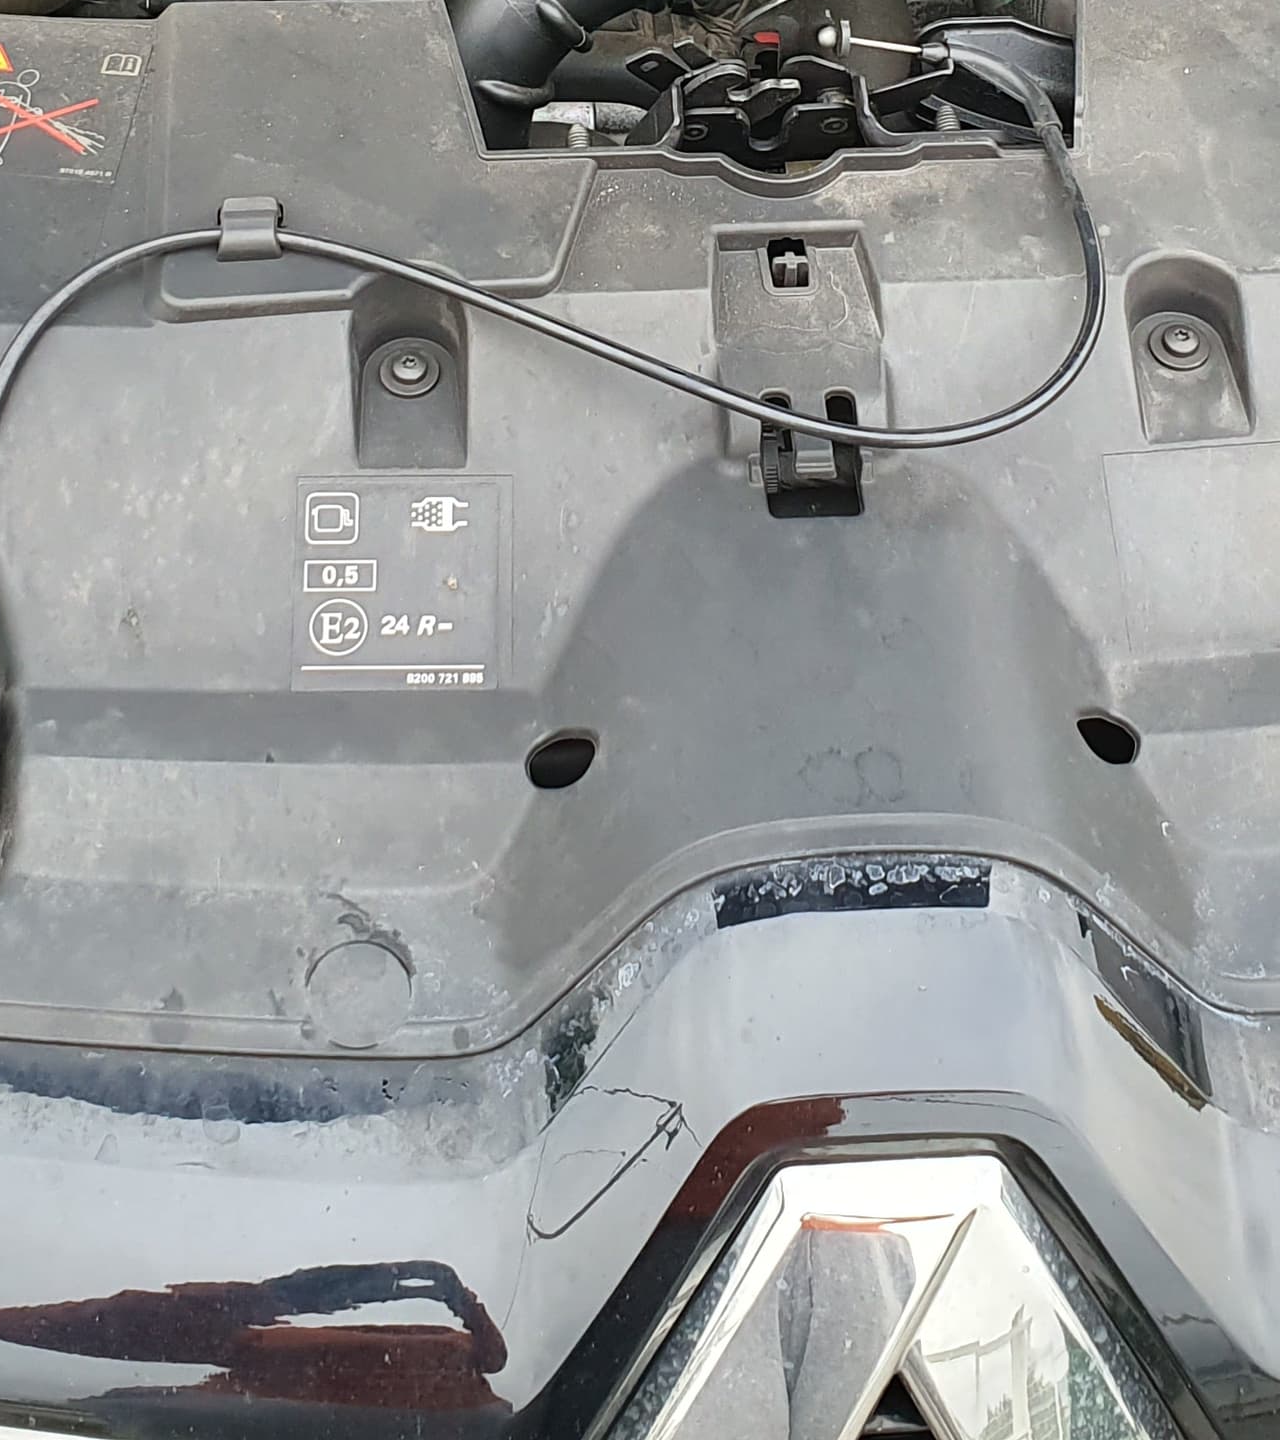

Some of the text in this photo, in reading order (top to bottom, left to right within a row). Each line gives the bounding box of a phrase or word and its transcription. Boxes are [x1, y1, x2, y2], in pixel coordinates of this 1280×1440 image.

[322, 565, 358, 587] 0,5
[320, 612, 361, 644] E2
[380, 615, 410, 636] 24
[438, 672, 459, 684] 721
